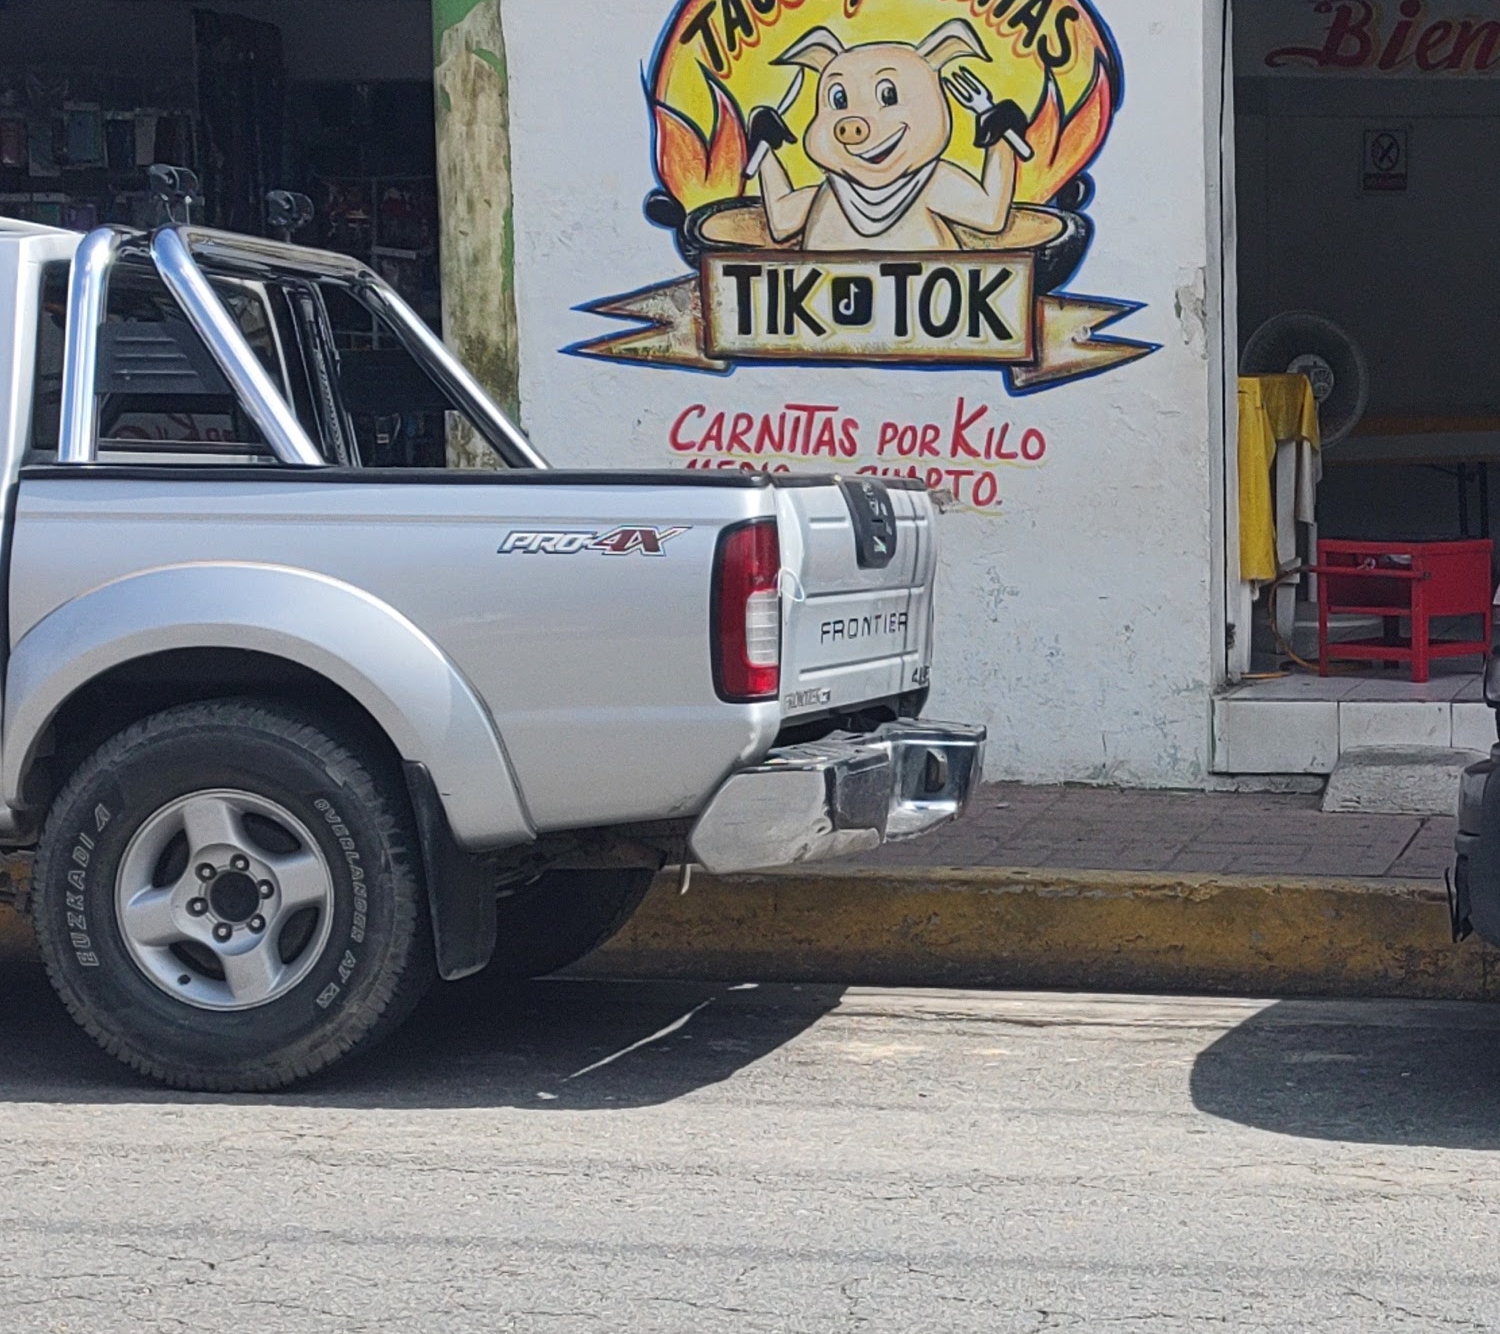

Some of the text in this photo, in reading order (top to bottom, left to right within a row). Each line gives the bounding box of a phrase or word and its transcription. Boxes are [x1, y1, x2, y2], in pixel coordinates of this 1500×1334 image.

[722, 262, 1014, 341] TIK TOK
[668, 396, 1047, 461] CARNITAS POR KILO
[820, 612, 908, 645] FRONTIER
